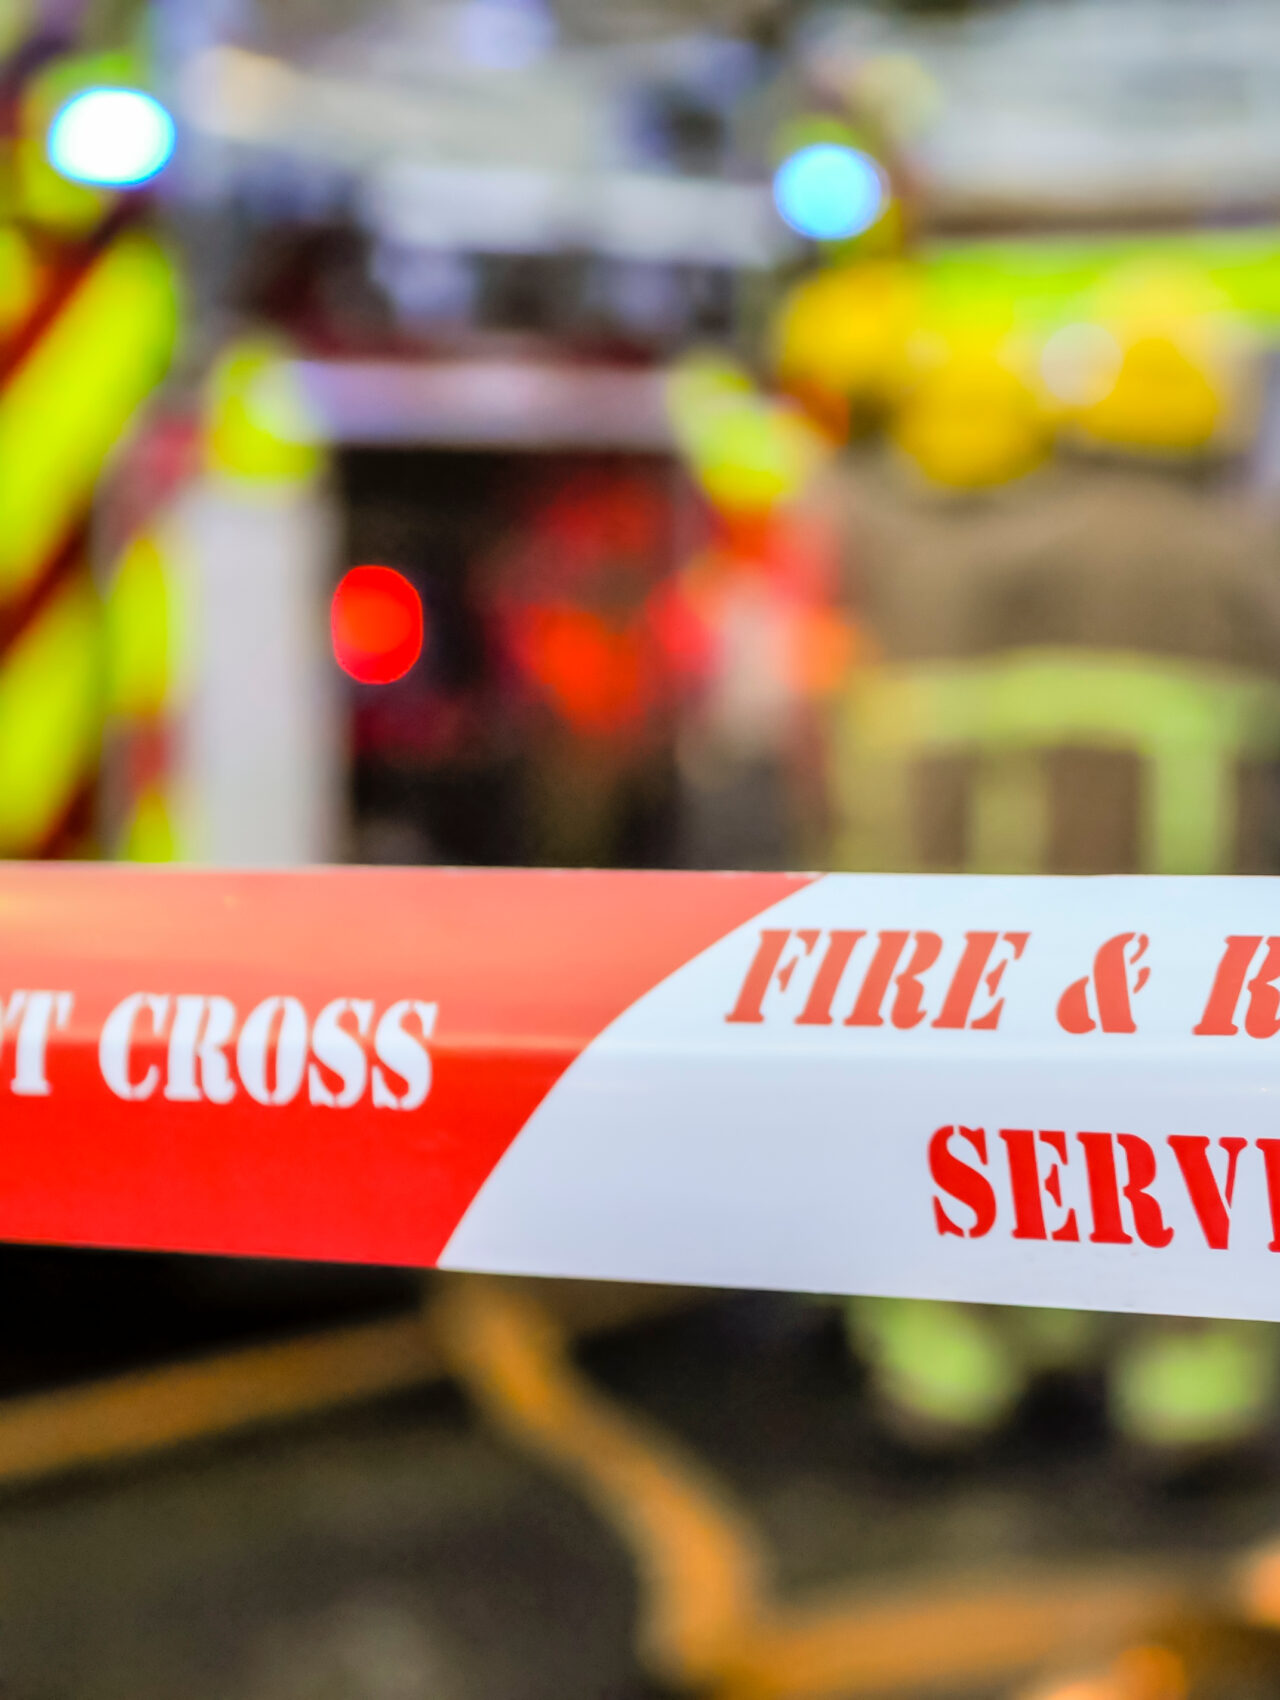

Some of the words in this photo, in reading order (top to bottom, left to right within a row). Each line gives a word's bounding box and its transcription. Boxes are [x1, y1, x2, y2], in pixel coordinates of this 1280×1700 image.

[724, 929, 1030, 1031] FIRE
[1055, 932, 1152, 1035] &
[0, 989, 75, 1096] T
[98, 991, 438, 1111] CROSS
